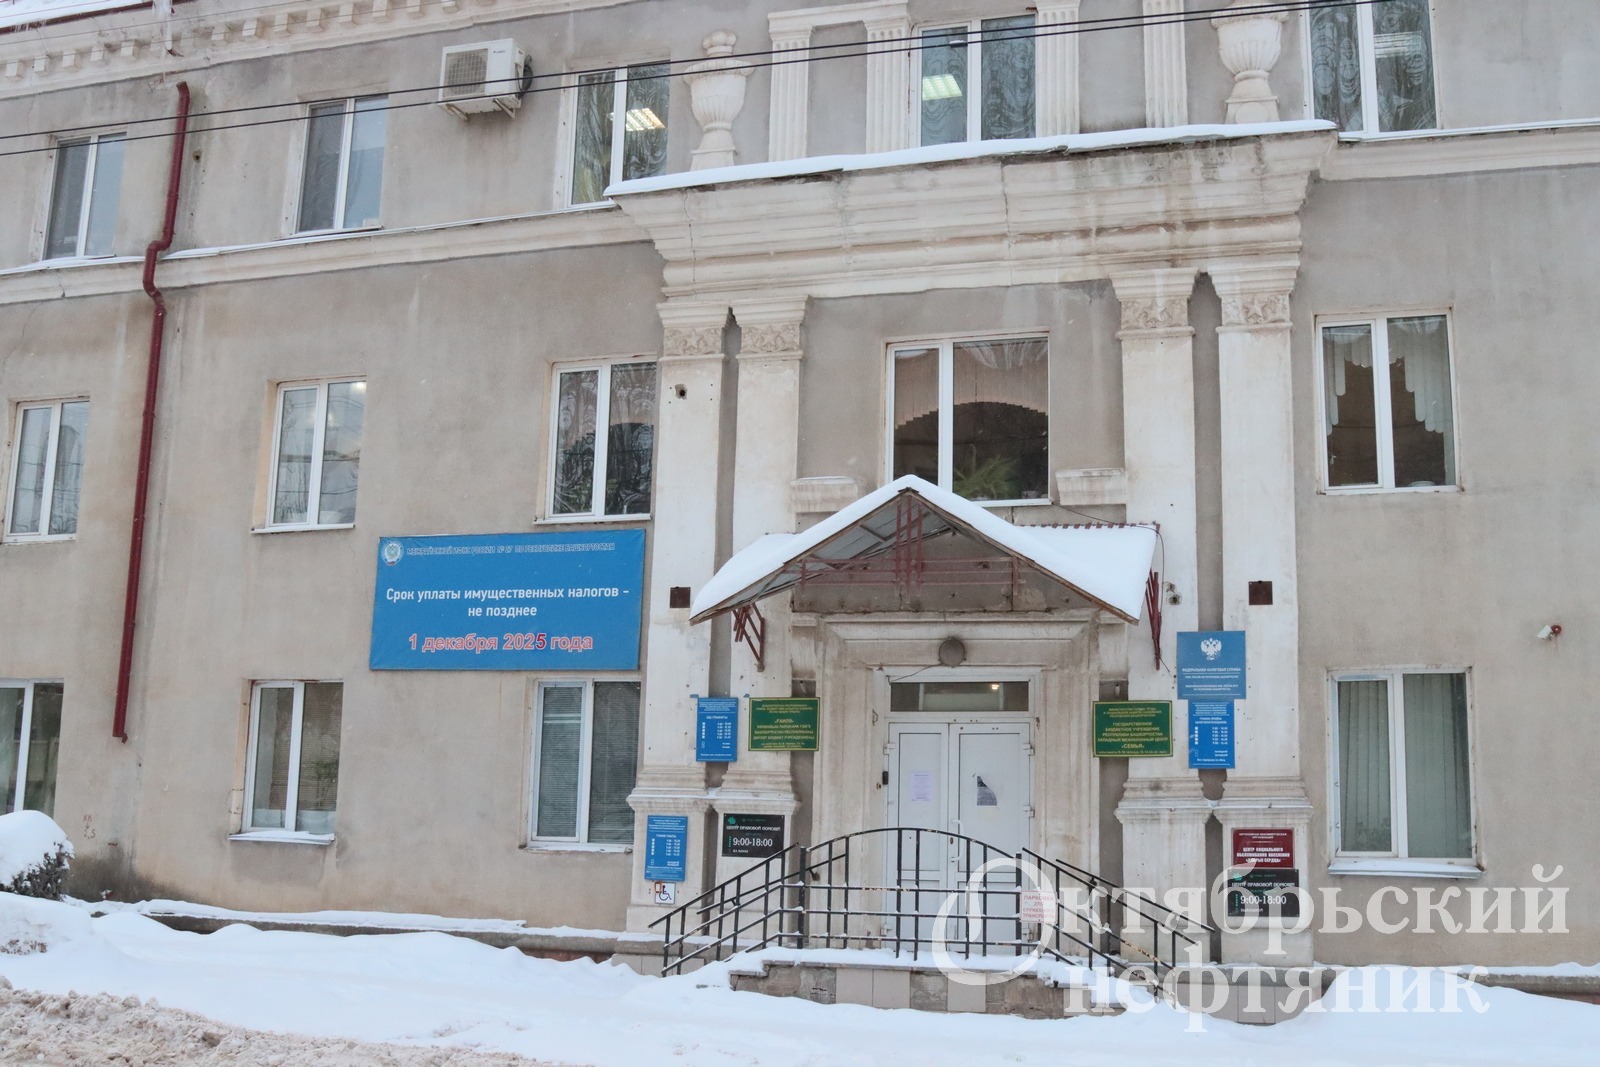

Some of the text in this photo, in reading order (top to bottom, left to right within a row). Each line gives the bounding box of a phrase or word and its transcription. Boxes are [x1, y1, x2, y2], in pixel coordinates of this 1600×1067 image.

[386, 588, 414, 603] Срок
[417, 589, 461, 602] уплаты
[464, 588, 564, 602] имущественных
[568, 587, 619, 598] налогов
[468, 606, 538, 618] не позднее
[408, 632, 594, 655] 1 декабря 2025 года
[733, 837, 773, 847] 9:00-18:00
[1240, 895, 1287, 905] 9:00-18:00
